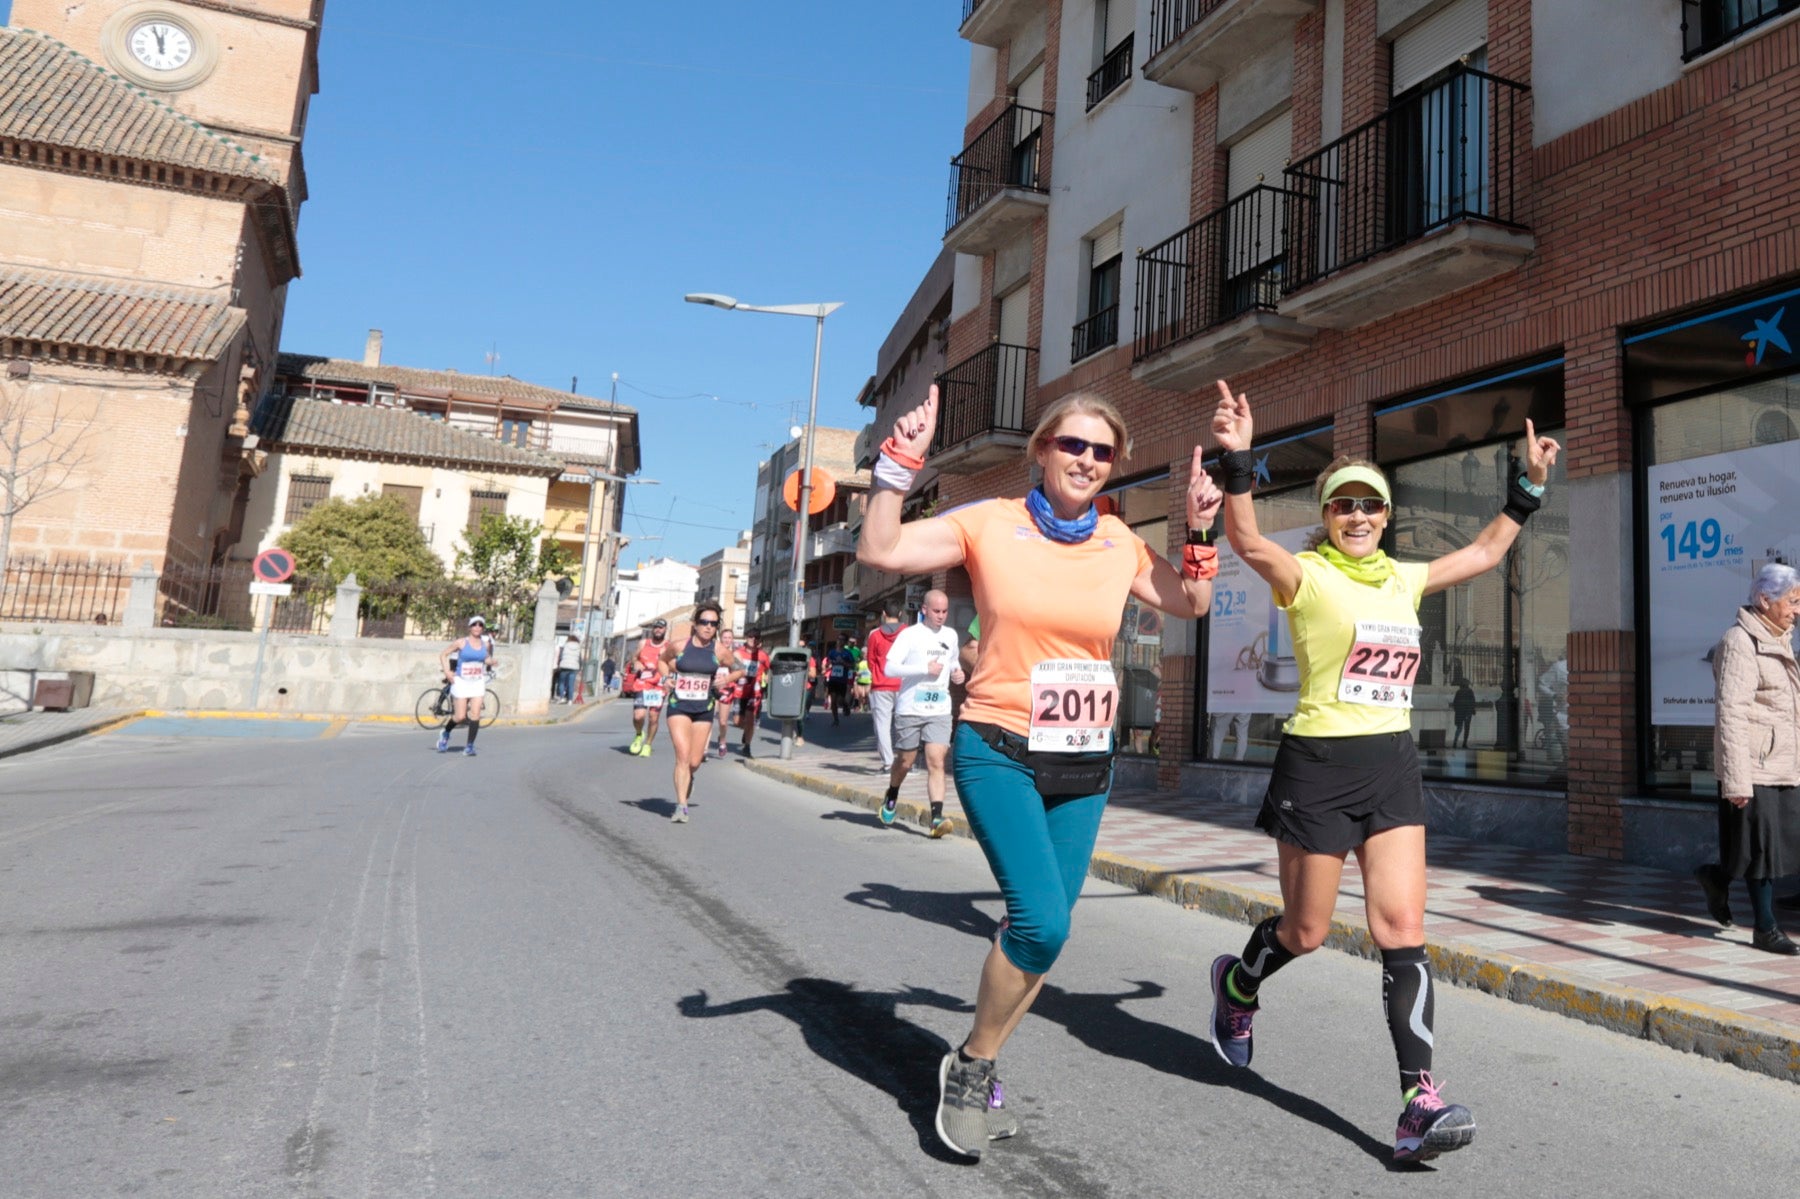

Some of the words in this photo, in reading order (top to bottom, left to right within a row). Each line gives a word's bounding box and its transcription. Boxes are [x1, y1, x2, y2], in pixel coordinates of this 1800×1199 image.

[1660, 478, 1696, 491] Renueva
[1697, 476, 1707, 485] tu
[1709, 471, 1737, 485] hogar,
[1660, 491, 1694, 504] renueva
[1696, 489, 1705, 498] tu
[1707, 483, 1736, 496] ilusión
[1660, 511, 1673, 522] por
[1660, 518, 1721, 562] 149
[1724, 546, 1744, 556] mes
[1057, 663, 1073, 672] GRAN
[1349, 647, 1419, 681] 2237
[679, 680, 708, 691] 2156
[924, 691, 939, 702] 38
[1038, 689, 1113, 722] 2011
